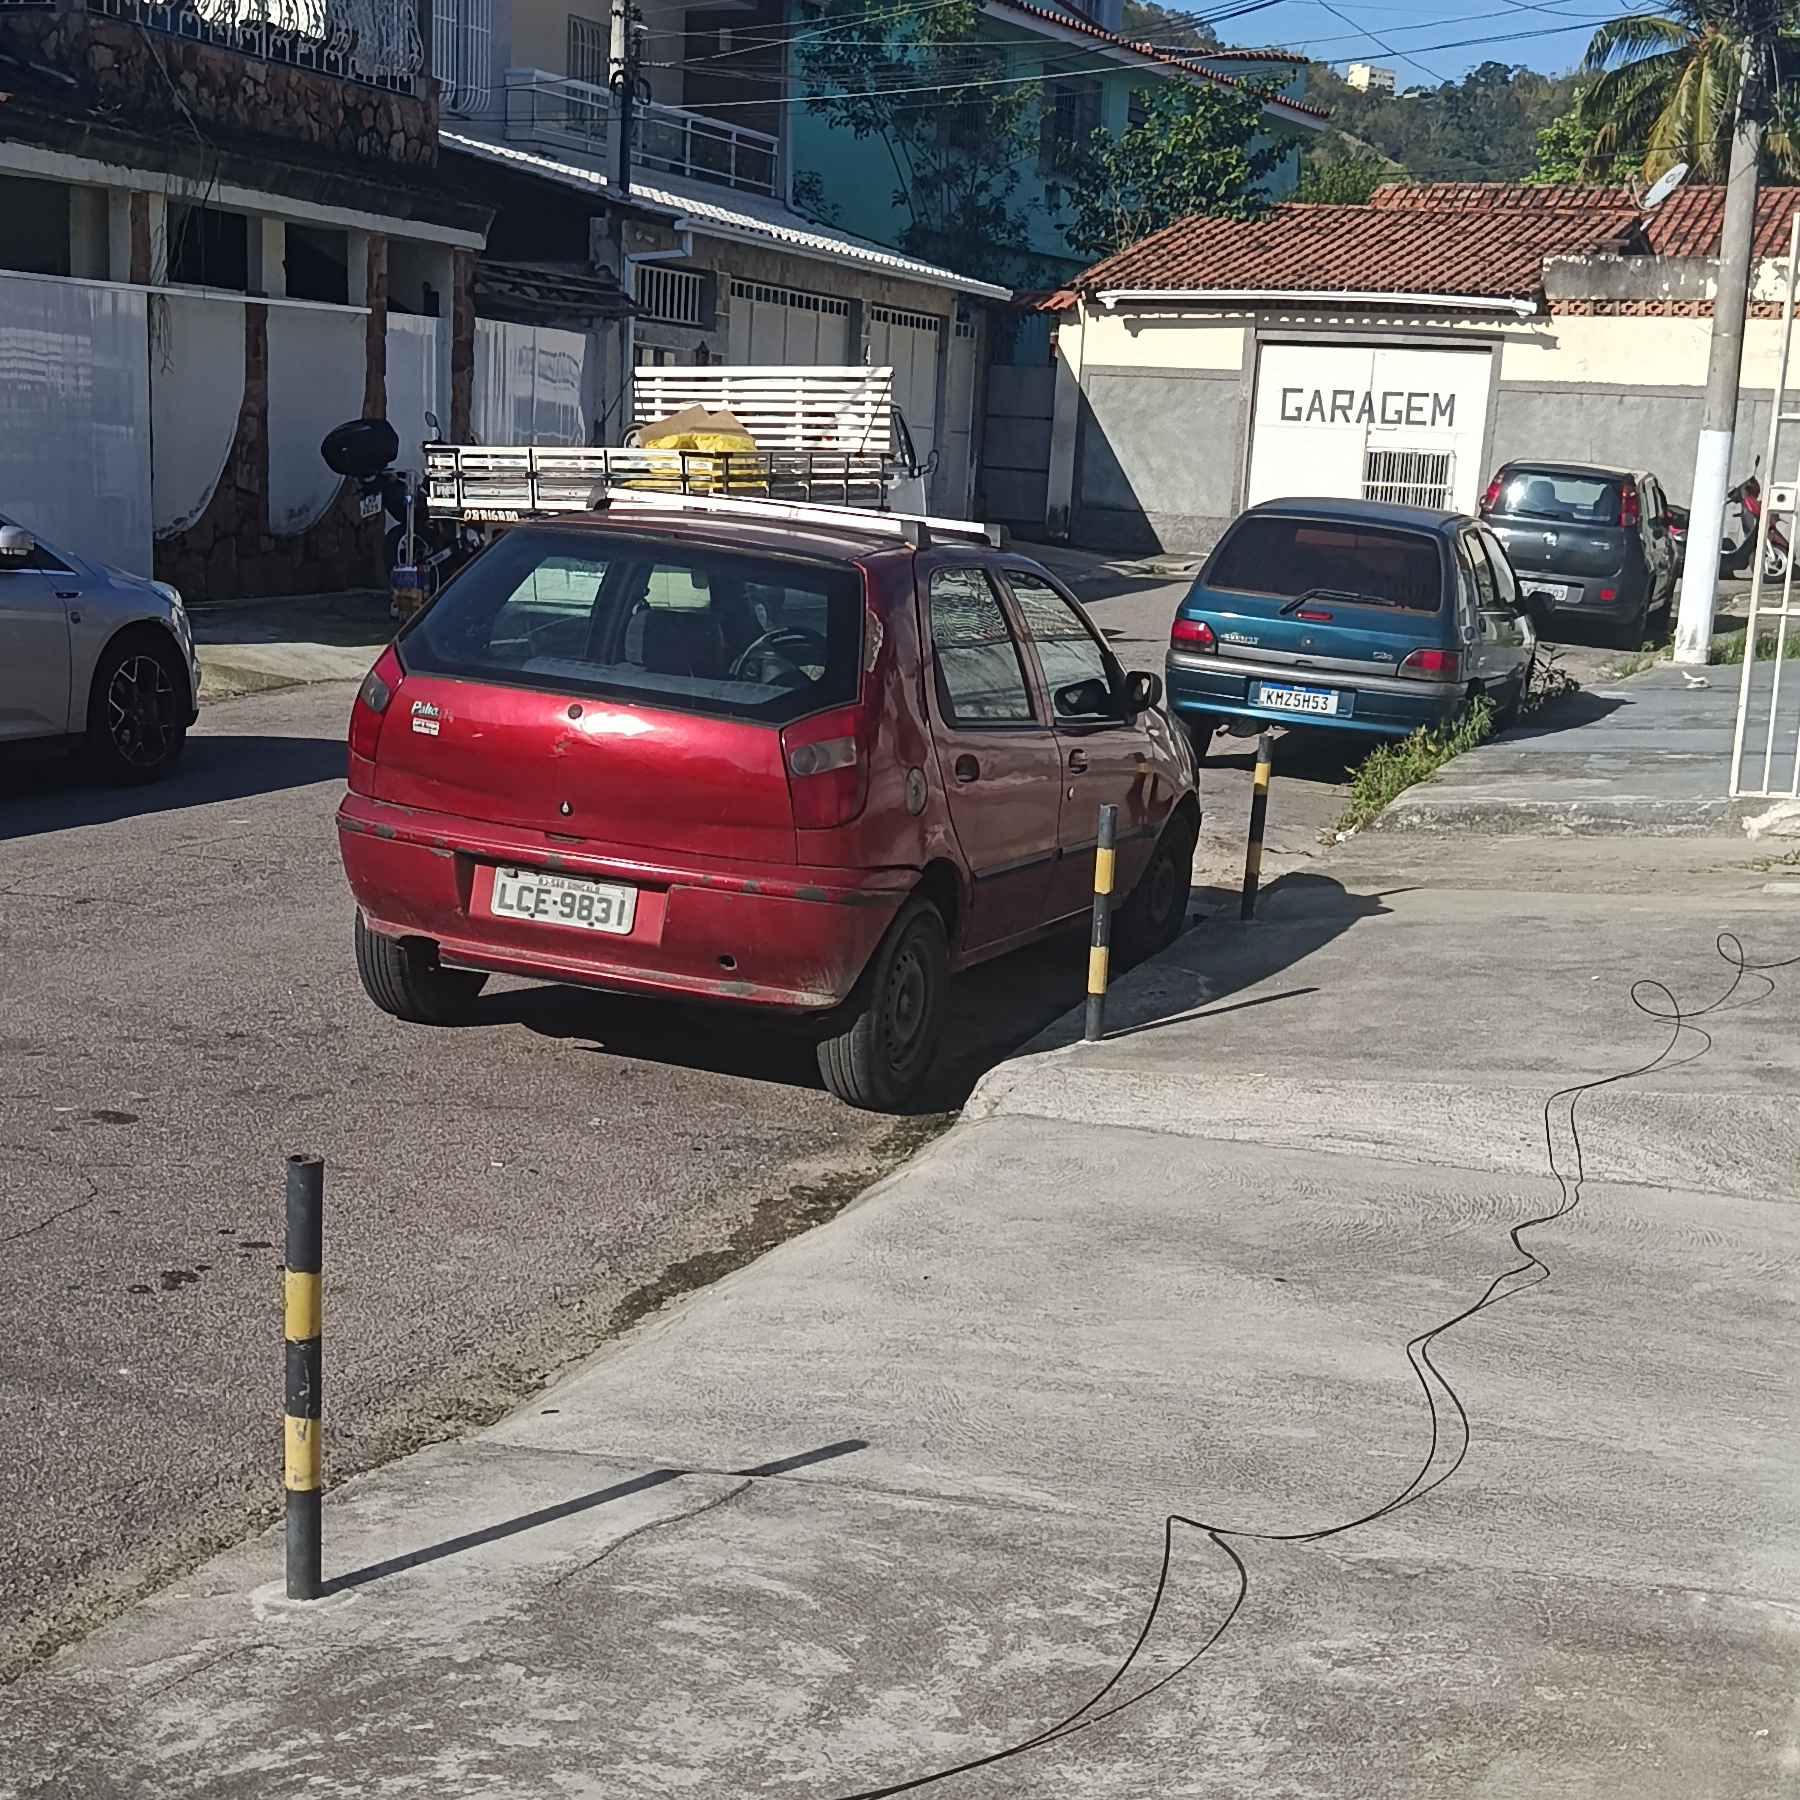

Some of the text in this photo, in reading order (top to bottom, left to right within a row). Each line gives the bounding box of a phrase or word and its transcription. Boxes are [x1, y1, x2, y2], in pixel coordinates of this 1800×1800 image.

[1280, 387, 1456, 427] GARAGEM
[463, 509, 519, 522] OBRIGADO
[1265, 689, 1329, 711] KMZ5H53
